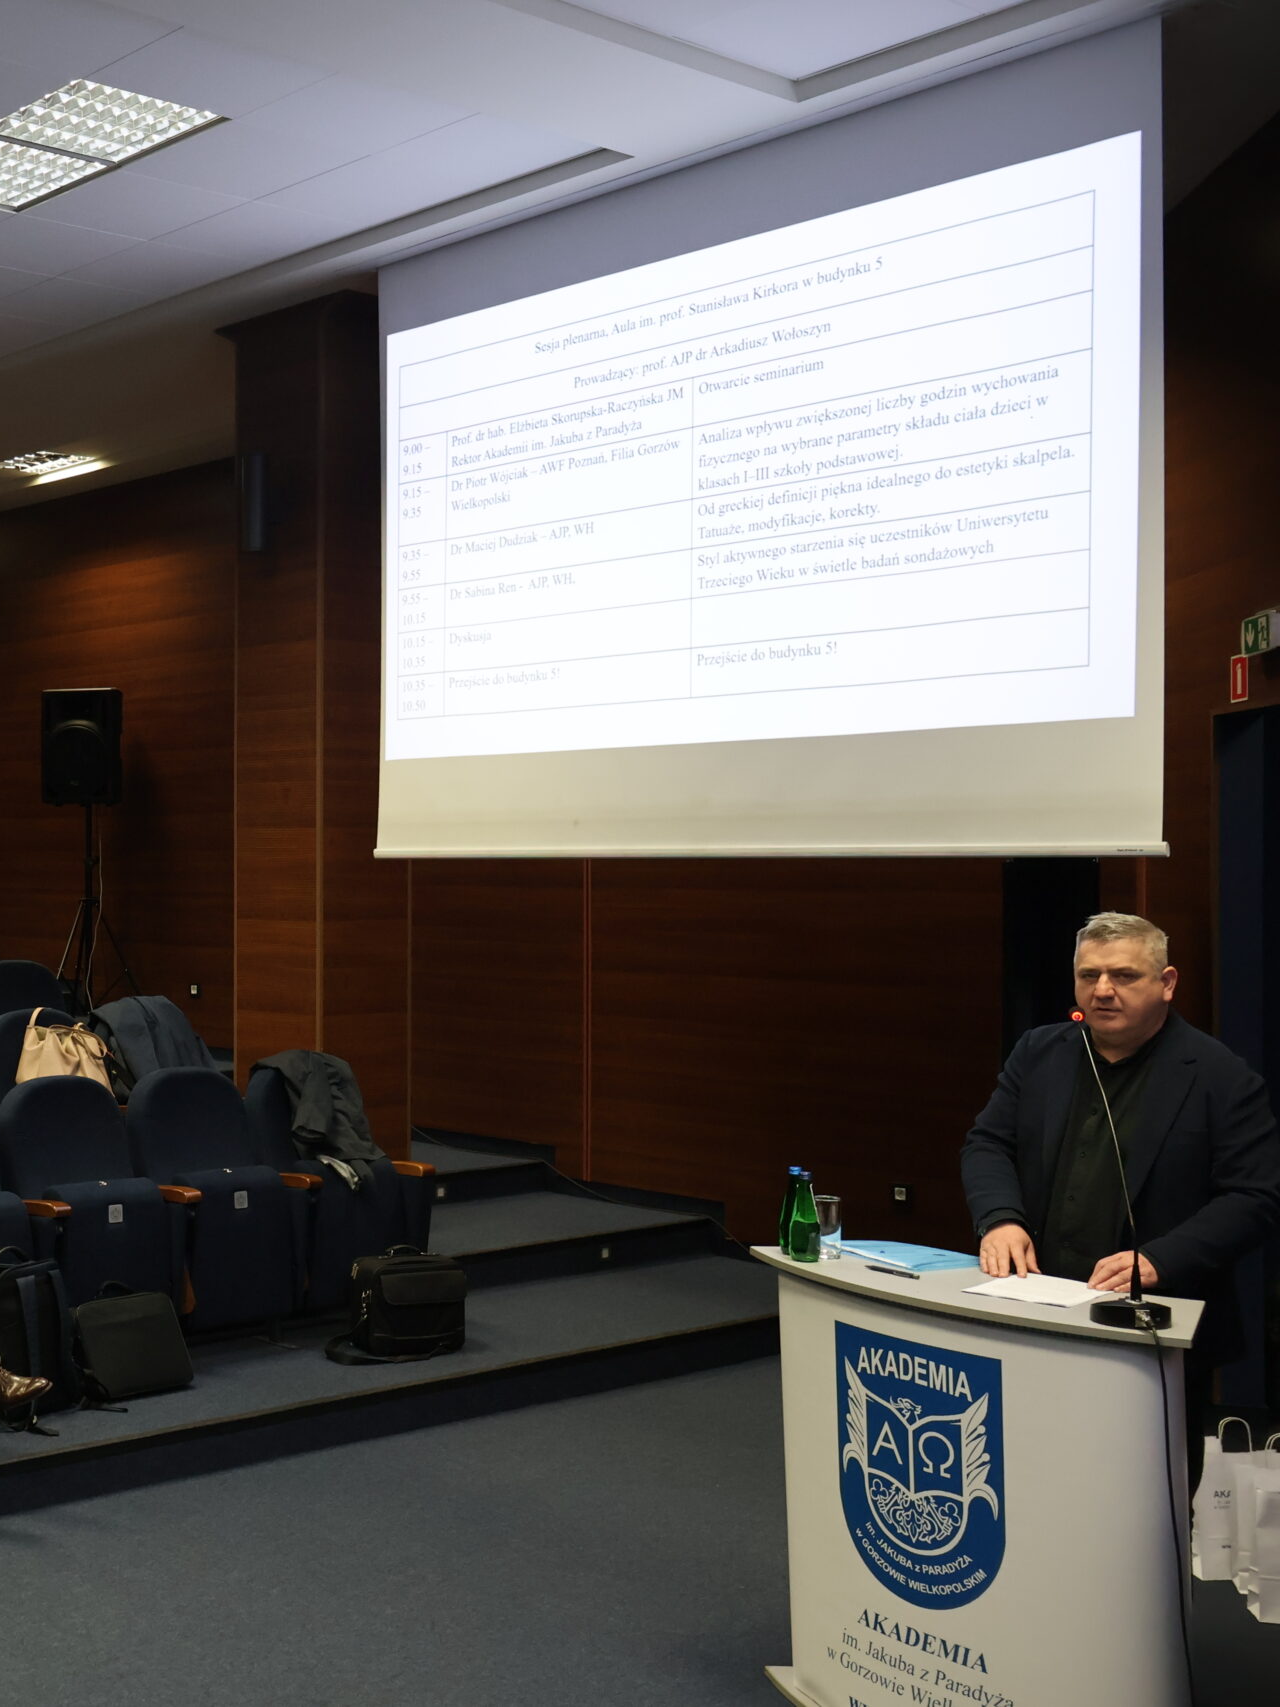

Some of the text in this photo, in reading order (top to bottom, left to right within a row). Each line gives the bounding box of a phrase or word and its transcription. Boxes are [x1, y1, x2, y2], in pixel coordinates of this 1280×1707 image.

[534, 340, 560, 354] Sesja
[610, 319, 637, 335] Aula
[638, 316, 656, 329] im.
[659, 305, 684, 327] prof.
[688, 293, 749, 316] Stanisława
[752, 281, 799, 300] Kirkora
[801, 277, 814, 288] w
[816, 261, 871, 285] budynku
[875, 255, 883, 271] 5
[641, 356, 666, 377] prof.
[670, 350, 693, 367] AJP
[694, 347, 708, 361] dr
[710, 336, 768, 358] Arkadiusz
[771, 322, 831, 343] Wołoszyn
[698, 360, 824, 394] Otwarcie seminarium
[475, 429, 485, 442] dr
[551, 392, 664, 426] Skorupska-Raczyńska
[666, 386, 684, 402] JM
[698, 364, 1059, 445] Analiza wpływu zwiększonej liczby godzin wychowania
[402, 442, 423, 456] 9.00
[451, 420, 642, 468] Rektor Akademii im. Jakuba z Paradyża
[698, 395, 1049, 469] fizycznego na wybrane parametry składu ciała dzieci w
[402, 461, 422, 476] 9.15
[451, 479, 464, 492] Dr
[465, 477, 487, 489] Piotr
[538, 458, 565, 475] AWF
[610, 447, 635, 462] Filia
[636, 439, 680, 456] Gorzów
[697, 444, 1075, 517] Od greckiej definicji piękna idealnego do estetyki skalpela.
[698, 472, 740, 491] klasach
[773, 460, 811, 478] szkoły
[816, 444, 903, 475] podstawowej.
[402, 485, 422, 500] 9.15
[450, 491, 511, 512] Wielkopolski
[402, 505, 422, 519] 9.35
[697, 502, 880, 539] Tatuaże, modyfikacje, korekty.
[402, 548, 421, 561] 9.35
[450, 543, 463, 556] Dr
[464, 537, 496, 554] Maciej
[498, 530, 538, 548] Dudziak
[573, 520, 595, 535] WH
[697, 508, 1049, 569] Styl aktywnego starzenia się uczestników Uniwersytetu
[401, 568, 421, 582] 9.55
[697, 539, 994, 590] Trzeciego Wieku w świetle badań sondażowych
[401, 592, 421, 606] 9.55
[449, 588, 462, 601] Dr
[464, 585, 496, 599] Sabina
[402, 611, 426, 626] 10.15
[403, 635, 426, 649] 10.15
[448, 631, 492, 647] Dyskusja
[696, 640, 837, 668] Przejście do budynku 5!
[402, 655, 426, 669] 10.35
[448, 667, 561, 690] Przejście do budynku 5!
[402, 679, 426, 693] 10.35
[402, 699, 426, 713] 10.50
[857, 1346, 973, 1402] AKADEMIA
[855, 1528, 987, 1595] w GORZOWIE WIELKOPOLSKIM
[876, 1537, 912, 1570] JAKUBA
[915, 1564, 921, 1573] z
[922, 1555, 973, 1575] PARADYŻA
[857, 1608, 989, 1674] AKADEMIA
[827, 1647, 837, 1660] w
[840, 1652, 905, 1696] Gorzowie
[842, 1628, 1014, 1707] im. Jakuba z Paradyża
